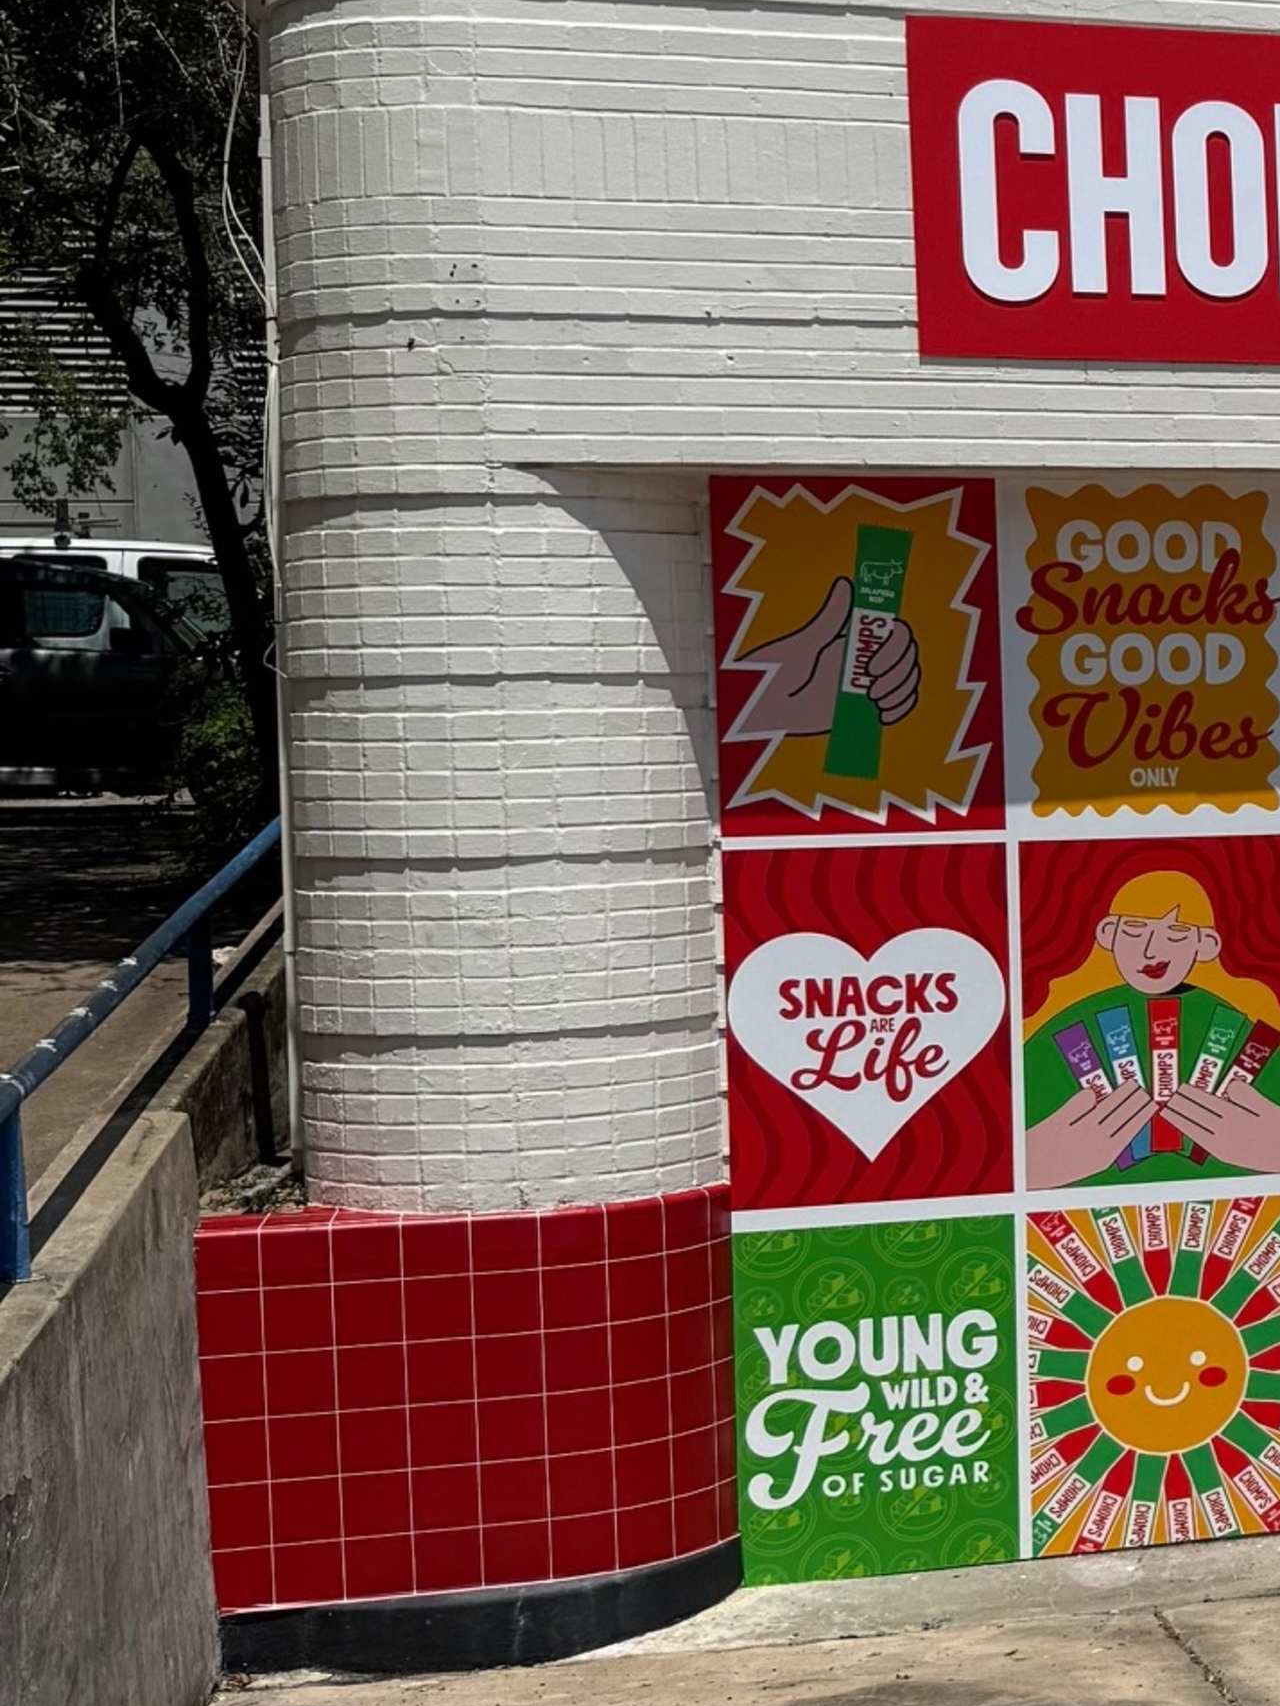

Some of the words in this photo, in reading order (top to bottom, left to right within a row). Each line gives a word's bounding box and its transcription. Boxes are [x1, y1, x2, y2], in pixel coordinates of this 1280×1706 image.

[1056, 520, 1242, 573] GOOD
[1060, 633, 1246, 686] GOOD
[1041, 686, 1274, 769] Vibes
[1130, 767, 1179, 789] ONLY
[778, 973, 959, 1020] SNACKS
[869, 1017, 895, 1034] ARE
[791, 1017, 950, 1103] Life
[1102, 1216, 1131, 1259] CHOMPS
[1185, 1205, 1207, 1249] CHOMPS
[1218, 1214, 1247, 1256] CHOMPS
[1061, 1237, 1097, 1277] CHOMPS
[1029, 1268, 1071, 1304] CHOMPS
[753, 1309, 999, 1385] YOUNG
[881, 1376, 958, 1411] WILD
[963, 1372, 989, 1404] &
[745, 1381, 992, 1510] Free
[822, 1472, 865, 1497] OF
[880, 1461, 992, 1493] SUGAR
[1051, 1477, 1086, 1518] CHOMPS
[1238, 1471, 1272, 1510] CHOMPS
[1088, 1495, 1118, 1538] CHOMPS
[1205, 1491, 1232, 1533] CHOMPS
